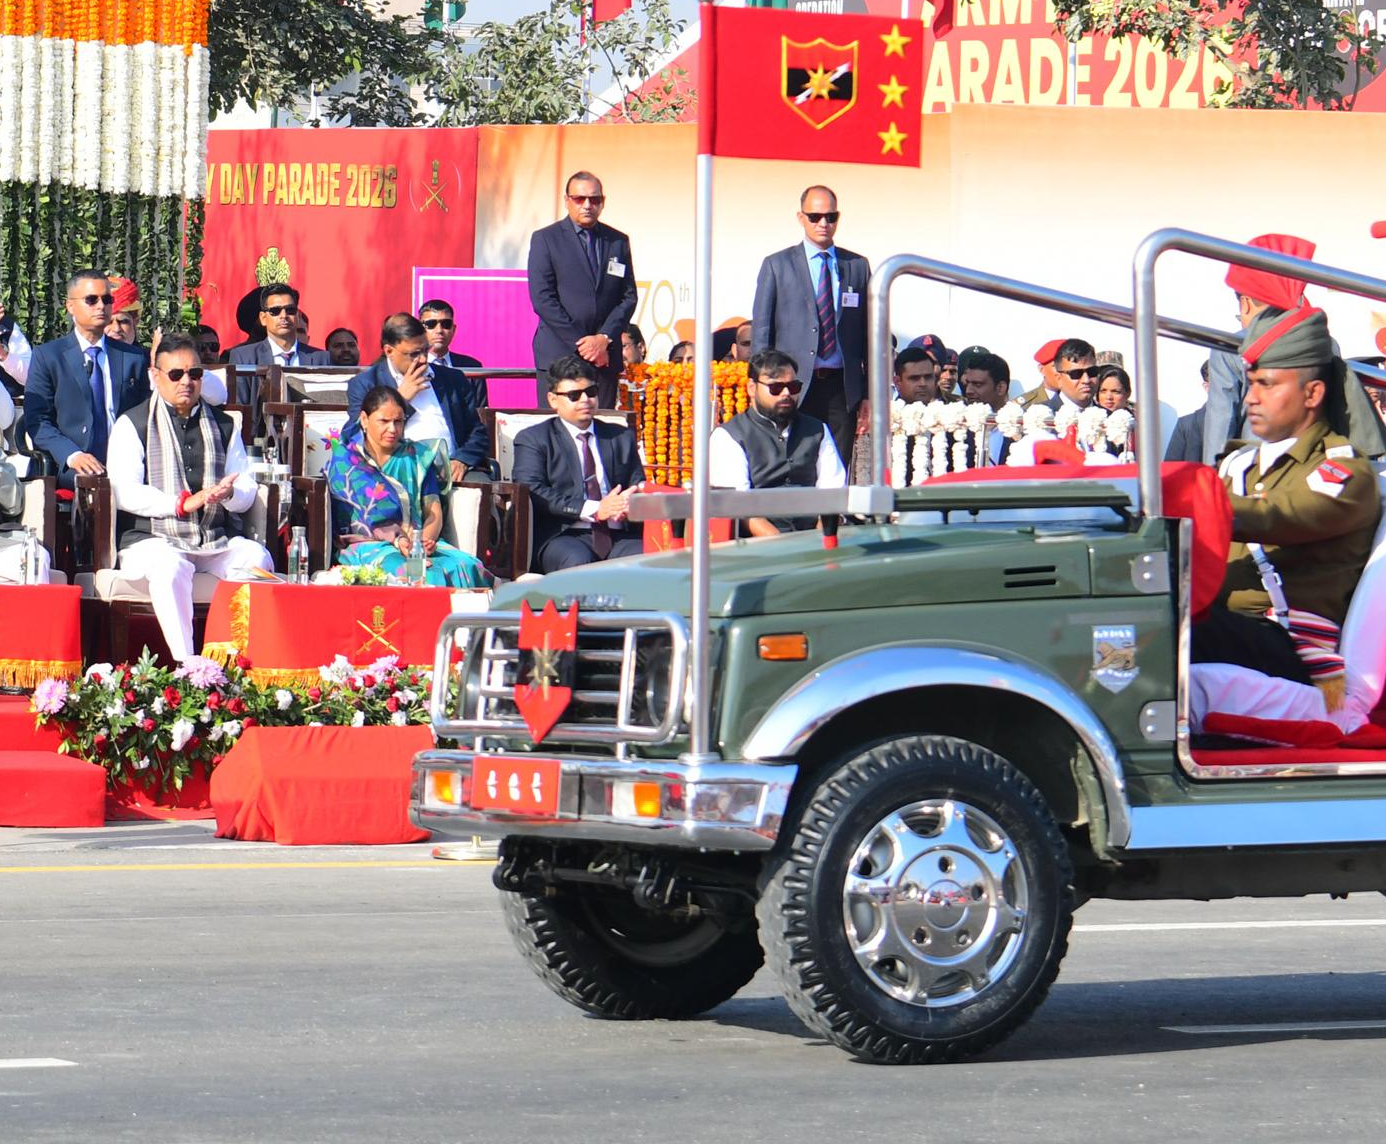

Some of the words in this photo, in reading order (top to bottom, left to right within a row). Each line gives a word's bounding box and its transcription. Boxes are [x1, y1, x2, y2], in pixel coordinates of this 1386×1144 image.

[921, 37, 1093, 114] ARADE
[1104, 34, 1234, 108] 2026
[220, 162, 259, 205] DAY
[263, 162, 341, 207] PARADE
[345, 164, 398, 208] 2026
